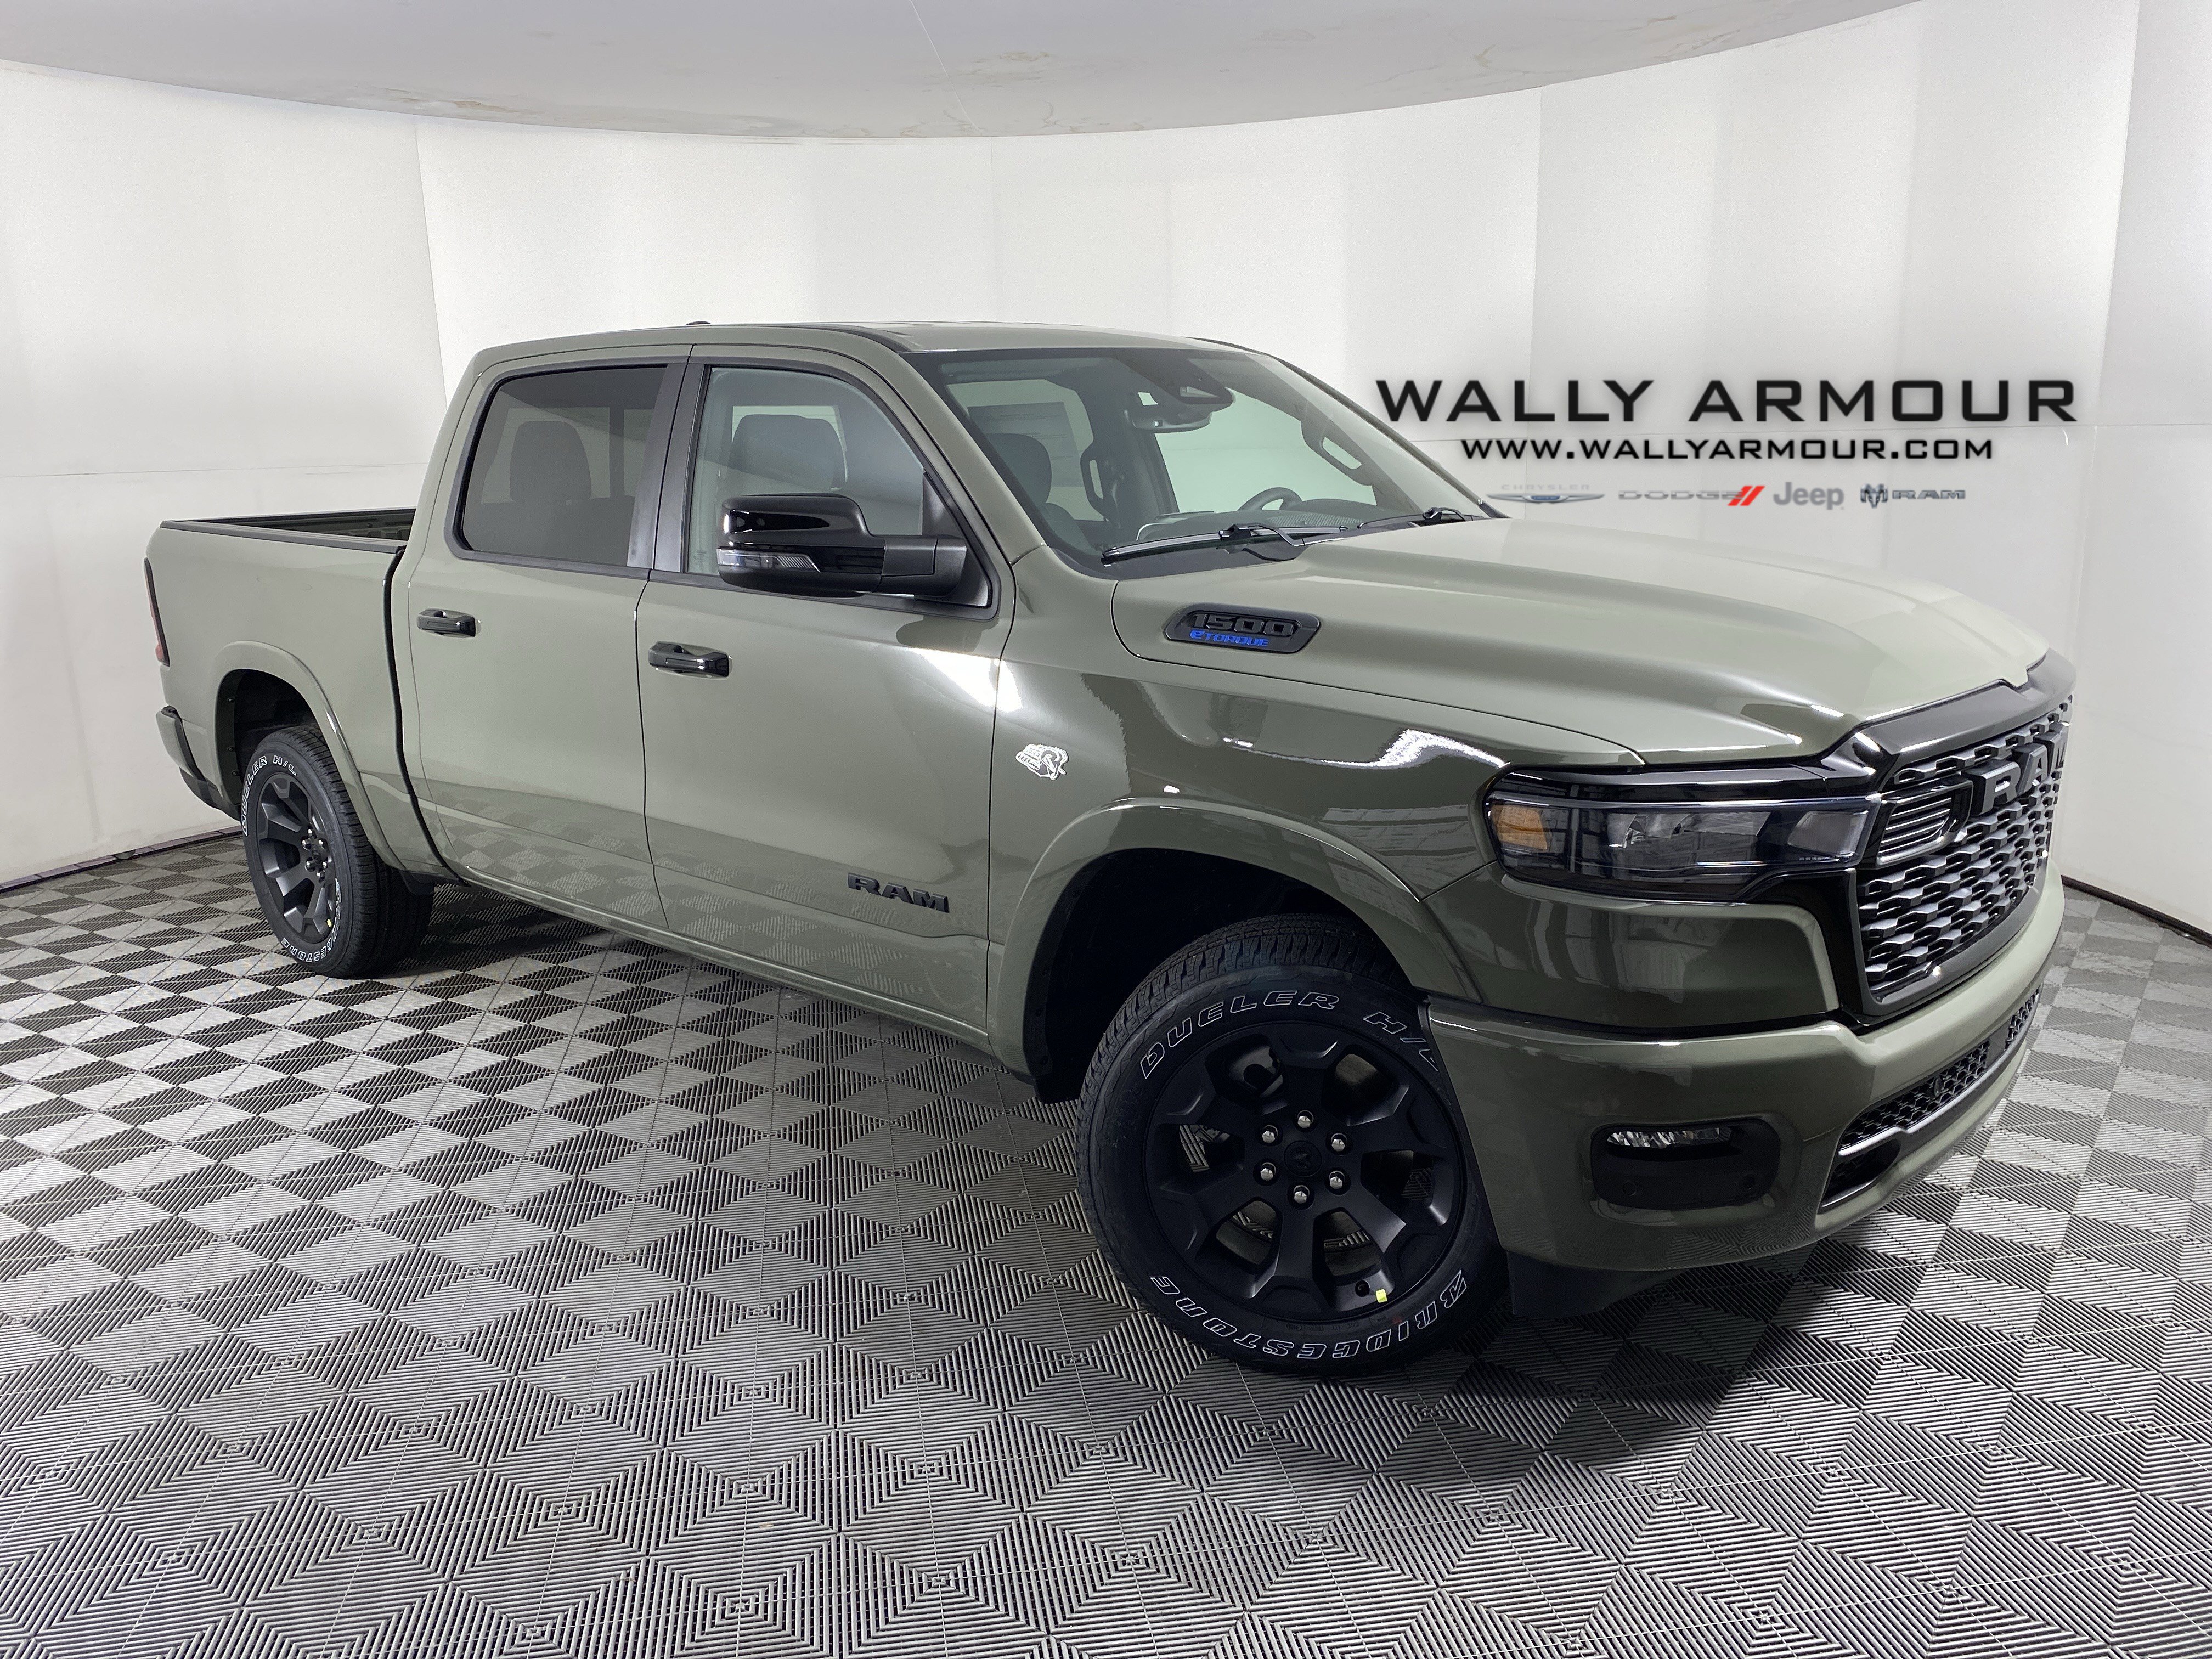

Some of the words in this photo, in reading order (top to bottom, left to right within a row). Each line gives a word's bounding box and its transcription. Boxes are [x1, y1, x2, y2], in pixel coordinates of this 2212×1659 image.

[1192, 613, 1294, 637] 1500
[241, 755, 268, 837] DUELER
[848, 872, 950, 913] RAM
[1140, 990, 1340, 1079] DUELER
[1150, 1269, 1467, 1360] BRIDGESTONE
